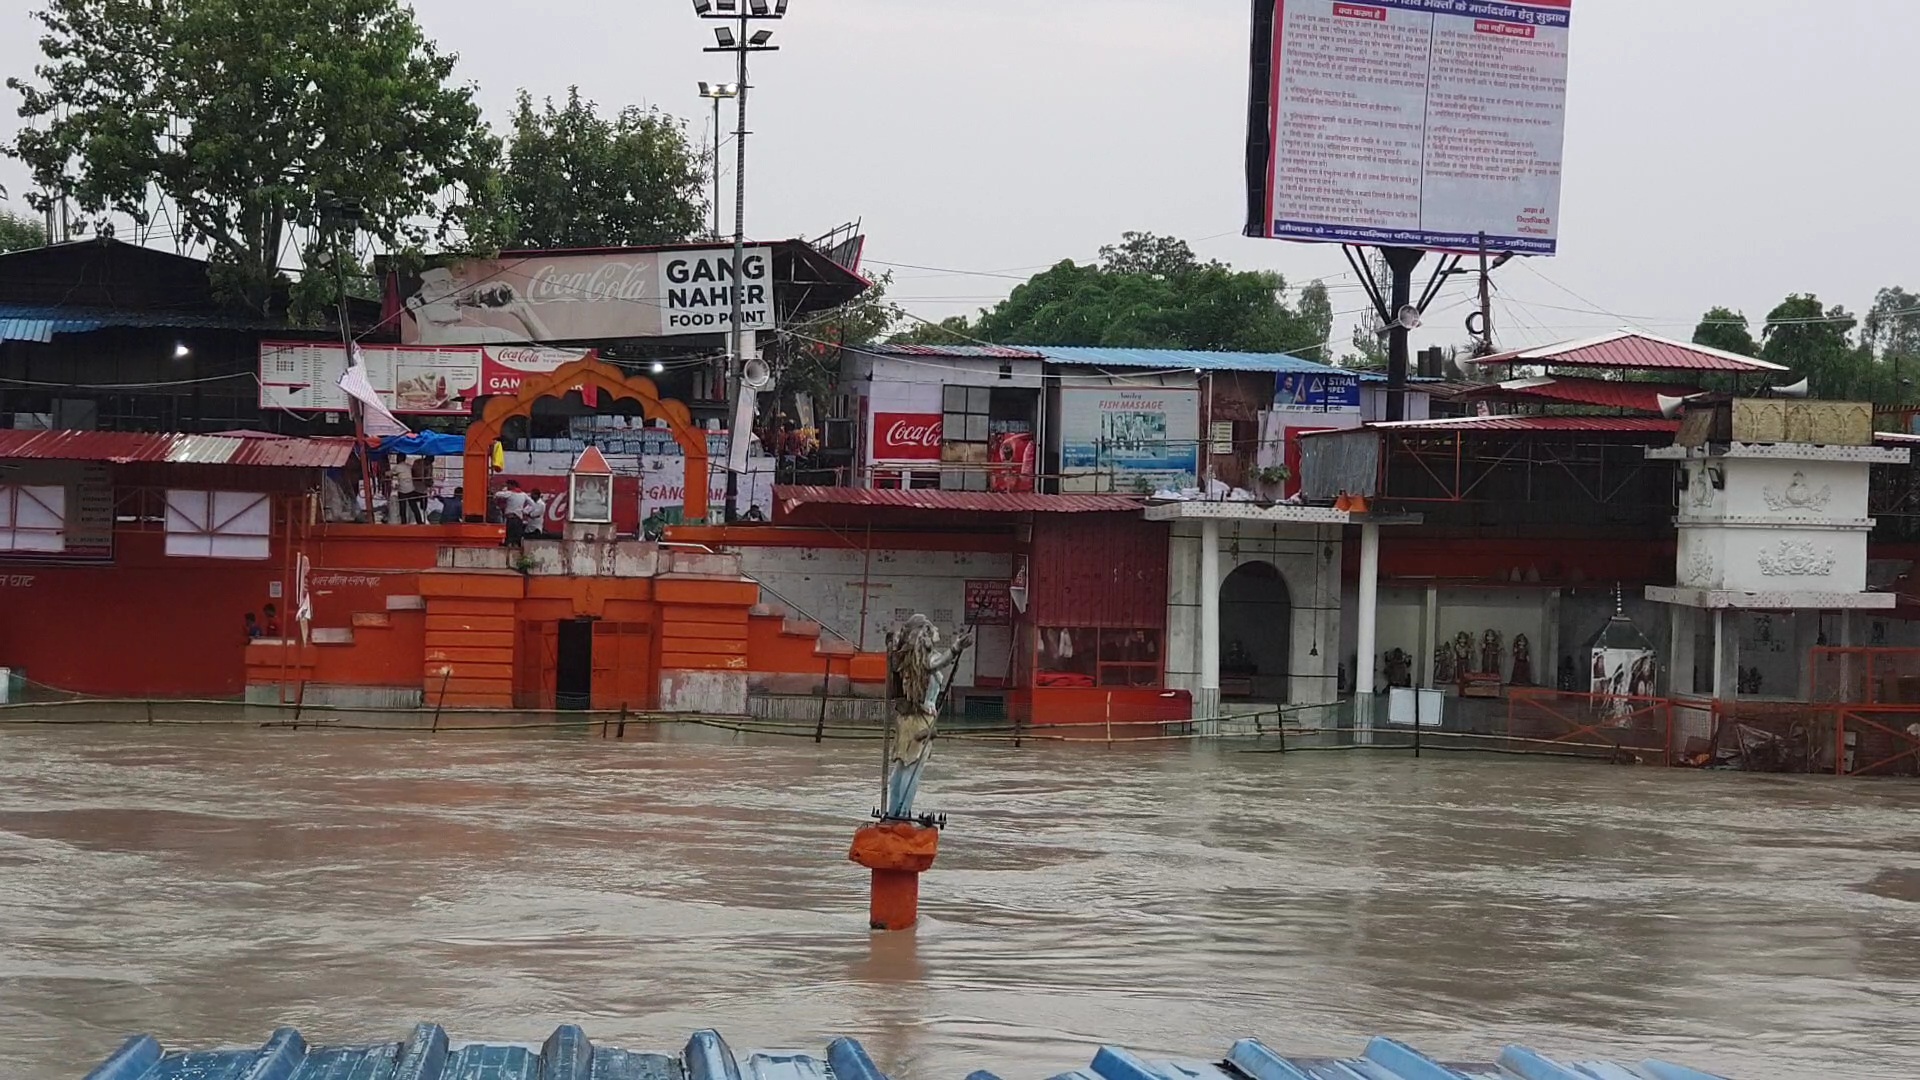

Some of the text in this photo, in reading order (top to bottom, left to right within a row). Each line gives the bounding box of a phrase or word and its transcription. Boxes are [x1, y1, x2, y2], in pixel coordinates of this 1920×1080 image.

[1455, 1, 1466, 11] के
[1469, 3, 1516, 18] मार्गदर्शन
[1517, 8, 1534, 23] हेतु
[1536, 13, 1566, 25] सुझाव
[1315, 226, 1324, 234] से
[1359, 229, 1392, 239] पालिका
[666, 255, 765, 284] GANG
[668, 284, 765, 308] NAHER
[670, 313, 714, 327] FOOD
[489, 377, 521, 389] GAN
[1098, 400, 1165, 410] FISH MASSAGE
[886, 419, 942, 447] Coca-Co
[10, 575, 36, 588] घाट
